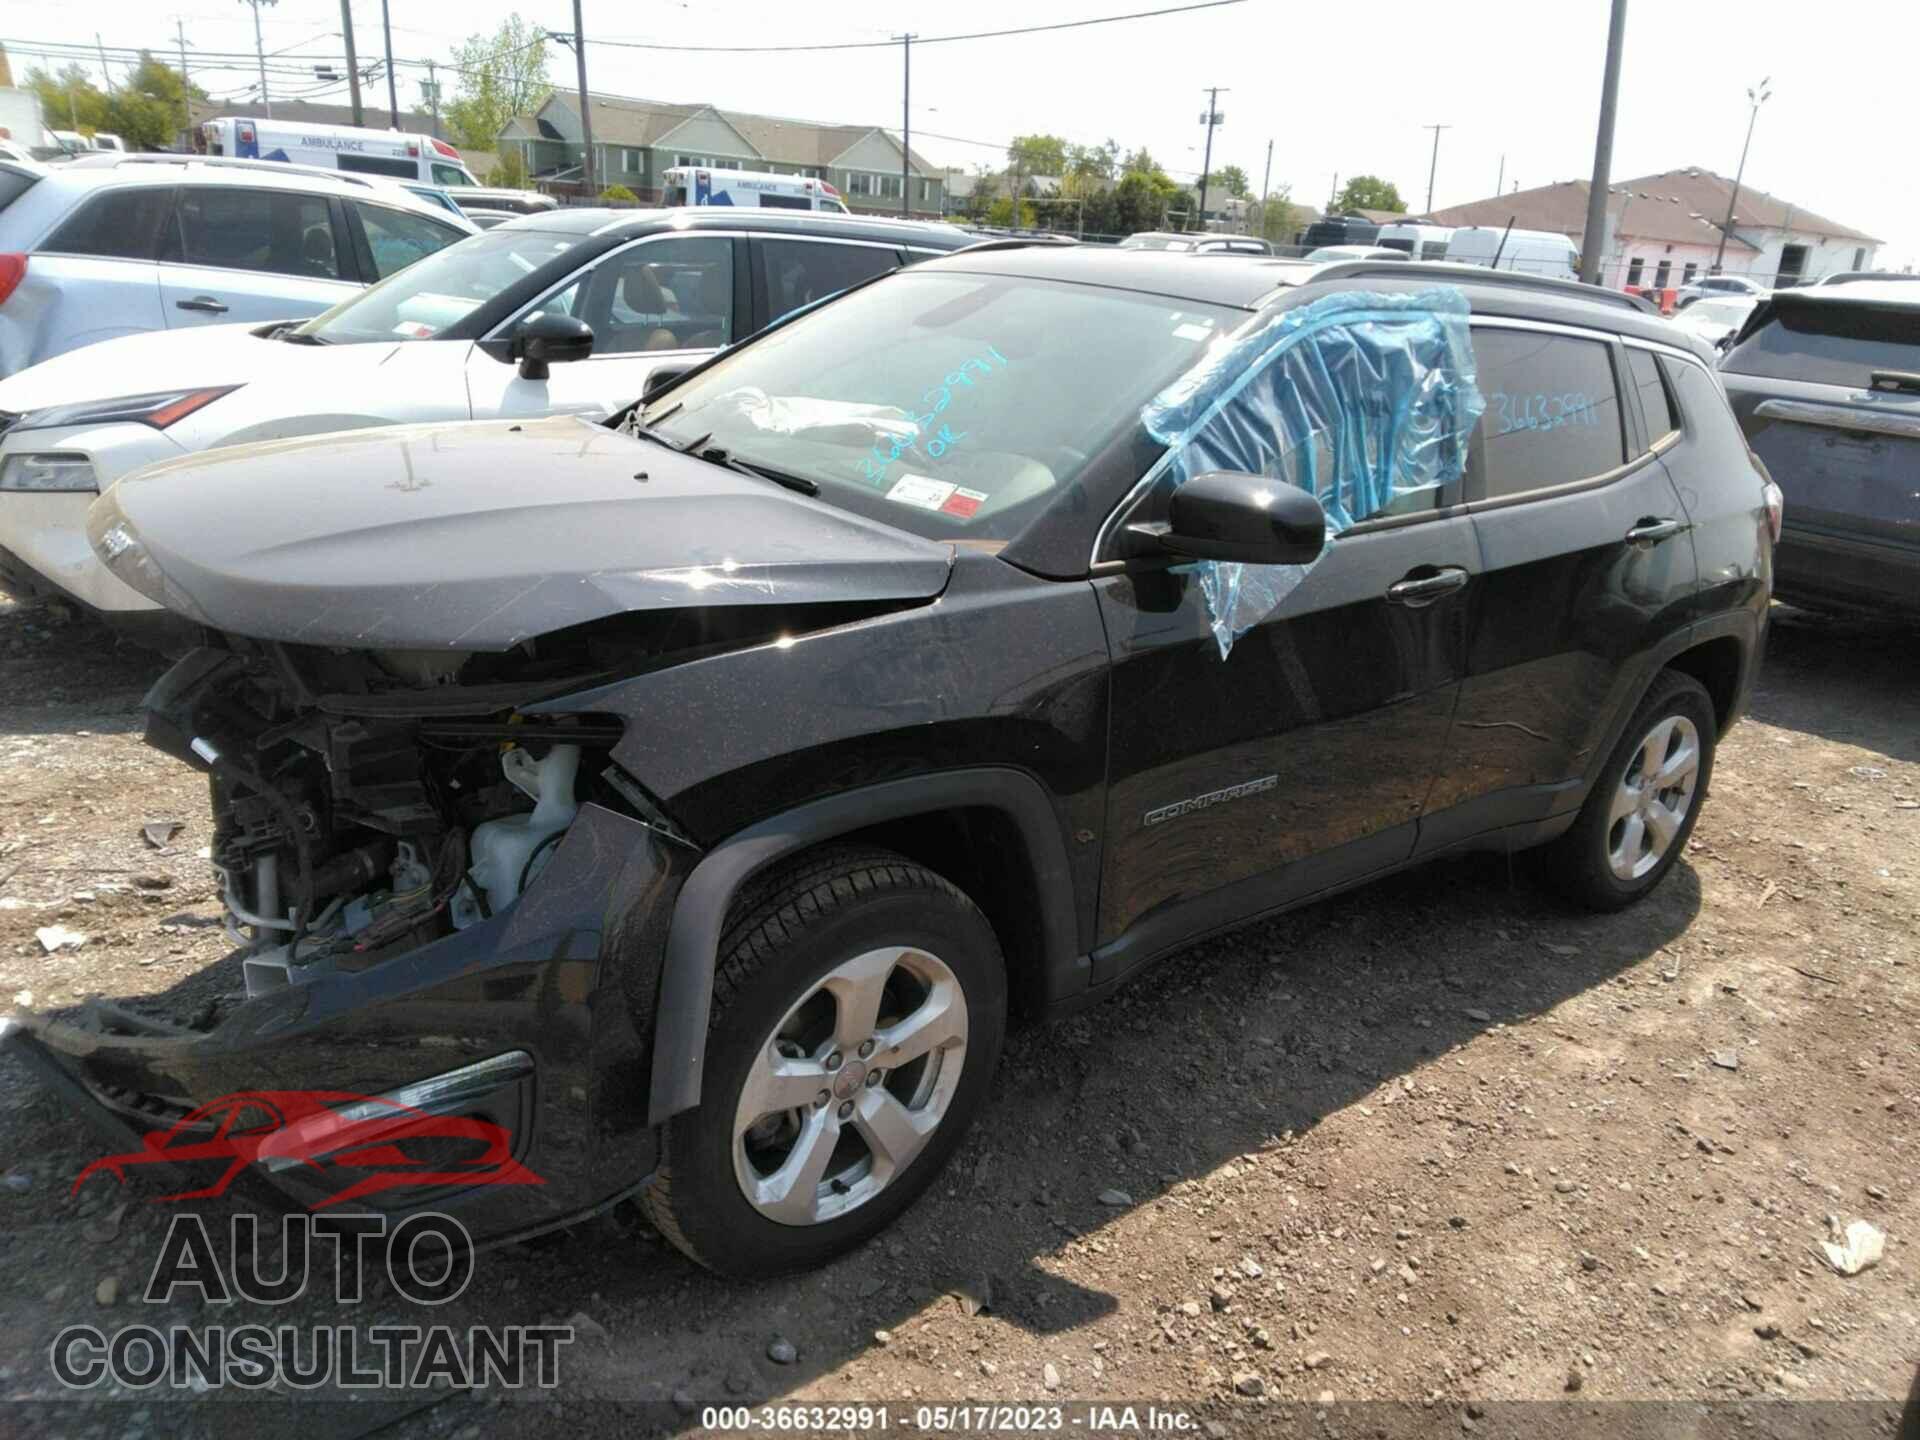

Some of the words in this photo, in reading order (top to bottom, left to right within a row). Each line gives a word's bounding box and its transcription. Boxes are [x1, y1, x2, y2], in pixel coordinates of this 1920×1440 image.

[301, 136, 364, 151] AMBULANCE
[737, 181, 777, 192] AMBULANCE
[928, 424, 968, 458] OK
[1143, 774, 1279, 826] COMPASS
